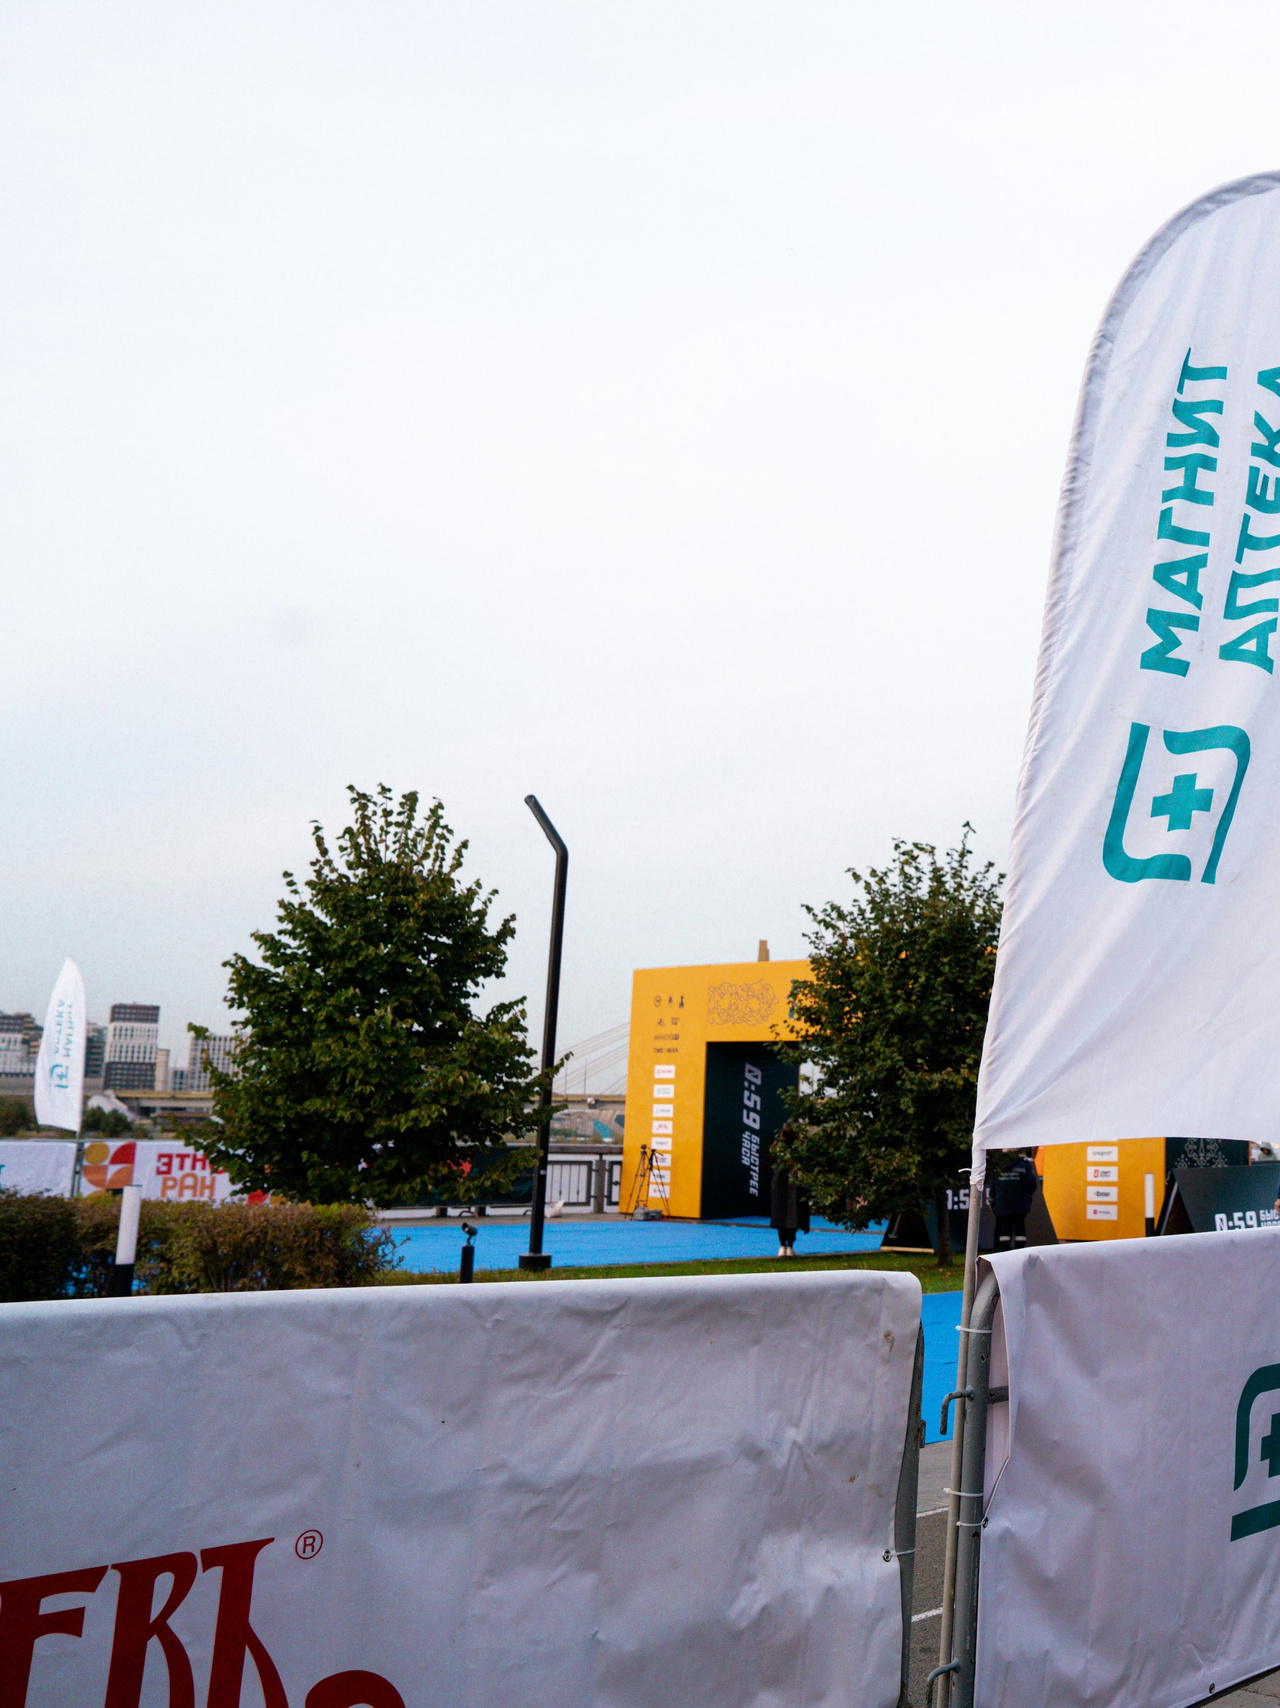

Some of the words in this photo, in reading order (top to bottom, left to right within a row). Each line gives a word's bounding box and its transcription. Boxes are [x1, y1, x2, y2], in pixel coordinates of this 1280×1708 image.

[1139, 347, 1228, 677] МАГНИТ
[742, 1062, 763, 1131] 0:59
[161, 1172, 217, 1198] РАН
[1214, 1210, 1258, 1231] 0:59
